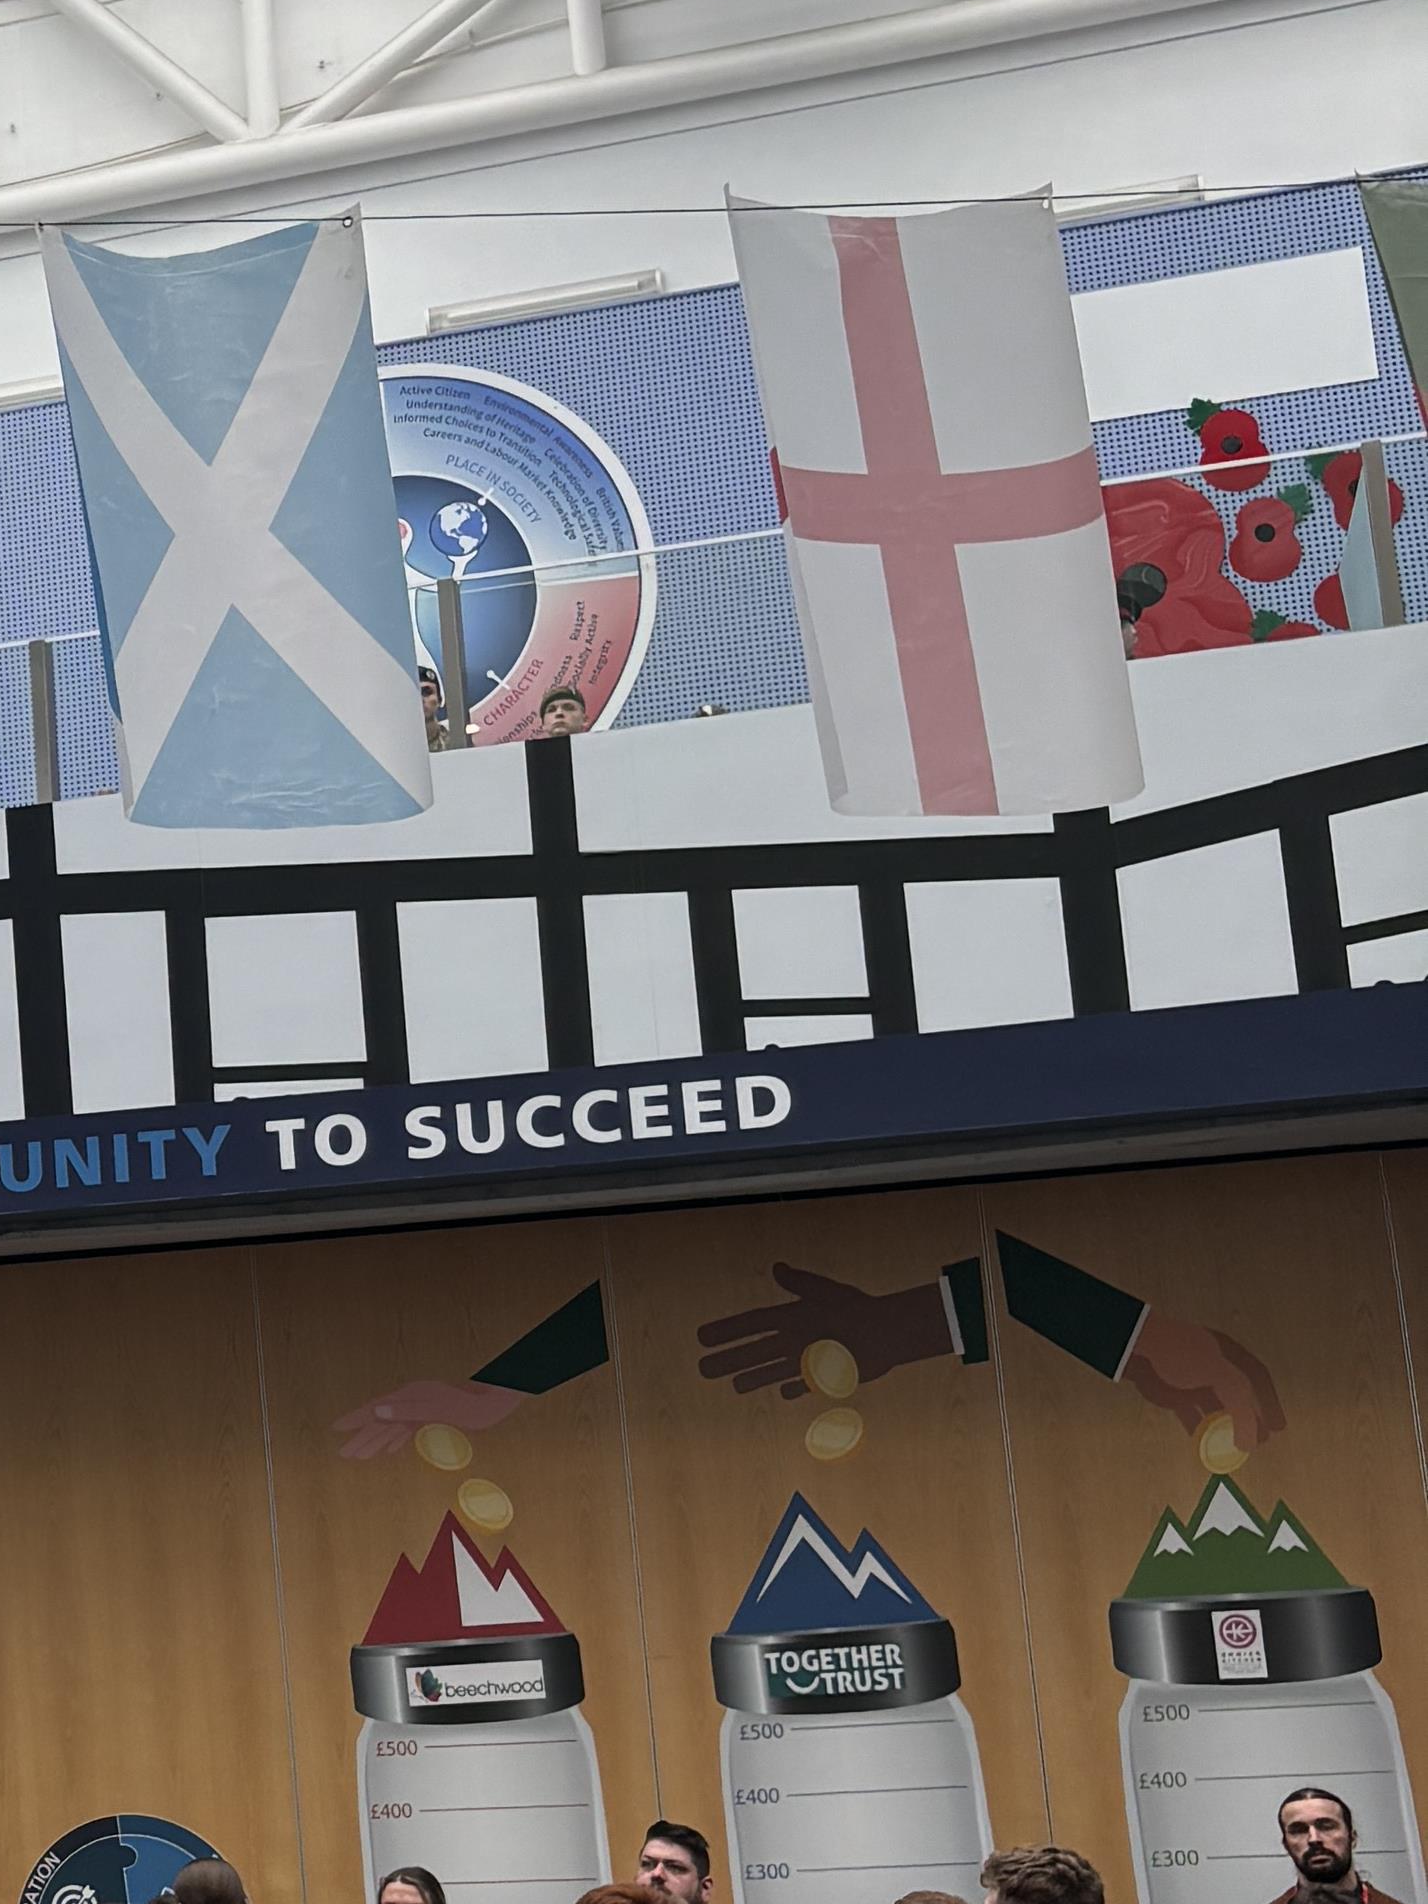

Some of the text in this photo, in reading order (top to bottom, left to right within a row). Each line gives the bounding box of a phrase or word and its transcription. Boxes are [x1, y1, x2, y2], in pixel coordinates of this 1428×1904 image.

[399, 385, 433, 396] Active
[434, 386, 471, 399] Citizen
[393, 413, 443, 425] Informed
[444, 415, 484, 434] Choices
[485, 427, 497, 439] to
[406, 399, 537, 445] Understanding of Heritage
[424, 428, 462, 442] Careers
[464, 436, 486, 449] and
[484, 443, 520, 469] Labour
[445, 454, 543, 523] PLACE IN SOCIETY
[483, 659, 544, 726] CHARACTER
[265, 1113, 367, 1170] TO
[404, 1075, 792, 1160] SUCCEED
[764, 1643, 904, 1675] TOGETHER
[445, 1677, 544, 1698] beechwood
[819, 1667, 905, 1695] TRUST
[1143, 1704, 1190, 1722] £500
[739, 1723, 784, 1741] £500
[376, 1740, 417, 1757] £500
[1139, 1771, 1187, 1790] £400
[735, 1788, 780, 1805] £400
[371, 1803, 412, 1820] £400
[1151, 1849, 1199, 1868] £300
[745, 1863, 790, 1880] £300
